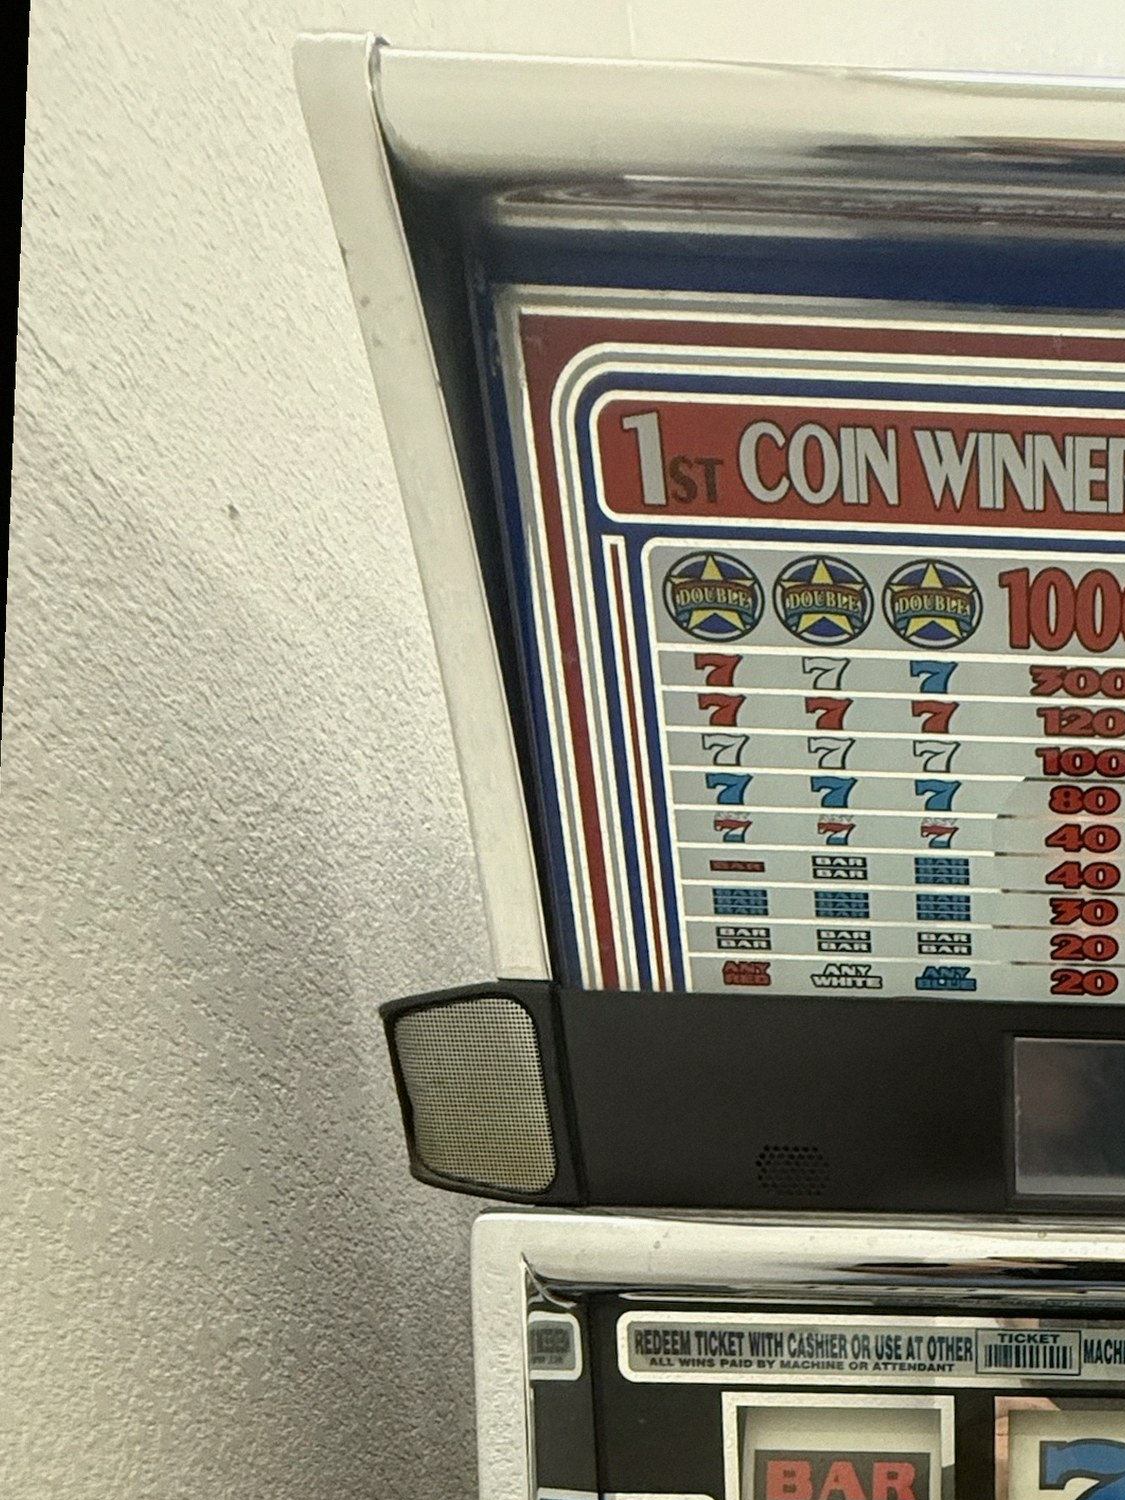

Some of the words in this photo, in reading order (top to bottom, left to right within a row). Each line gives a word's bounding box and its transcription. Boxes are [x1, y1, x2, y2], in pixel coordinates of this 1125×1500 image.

[738, 419, 901, 508] COIN
[678, 585, 751, 609] DOUBLE
[789, 588, 860, 612] DOUBLE
[898, 592, 969, 616] DOUBLE
[694, 653, 743, 687] 7
[801, 656, 850, 691] 7
[910, 659, 958, 694] 7
[1048, 785, 1122, 815] 80
[1044, 823, 1121, 854] 40
[1044, 860, 1121, 891] 40
[1049, 897, 1118, 927] 30
[1049, 933, 1118, 961] 20
[811, 974, 883, 989] WHITE
[823, 961, 871, 978] ANY
[1050, 968, 1118, 996] 20
[635, 1329, 691, 1356] REDEEM
[695, 1330, 745, 1357] TICKET
[749, 1331, 782, 1358] WITH
[788, 1332, 847, 1360] CASHIER
[850, 1334, 871, 1360] OR
[875, 1334, 902, 1360] USE
[906, 1335, 924, 1361] AT
[927, 1335, 973, 1362] OTHER
[997, 1333, 1061, 1344] TICKET
[648, 1358, 676, 1367] ALL
[680, 1358, 715, 1368] WINS
[720, 1359, 753, 1369] PAID
[759, 1360, 776, 1369] BY
[780, 1360, 845, 1370] MACHINE
[848, 1361, 869, 1371] OR
[872, 1361, 955, 1372] ATTENDANT
